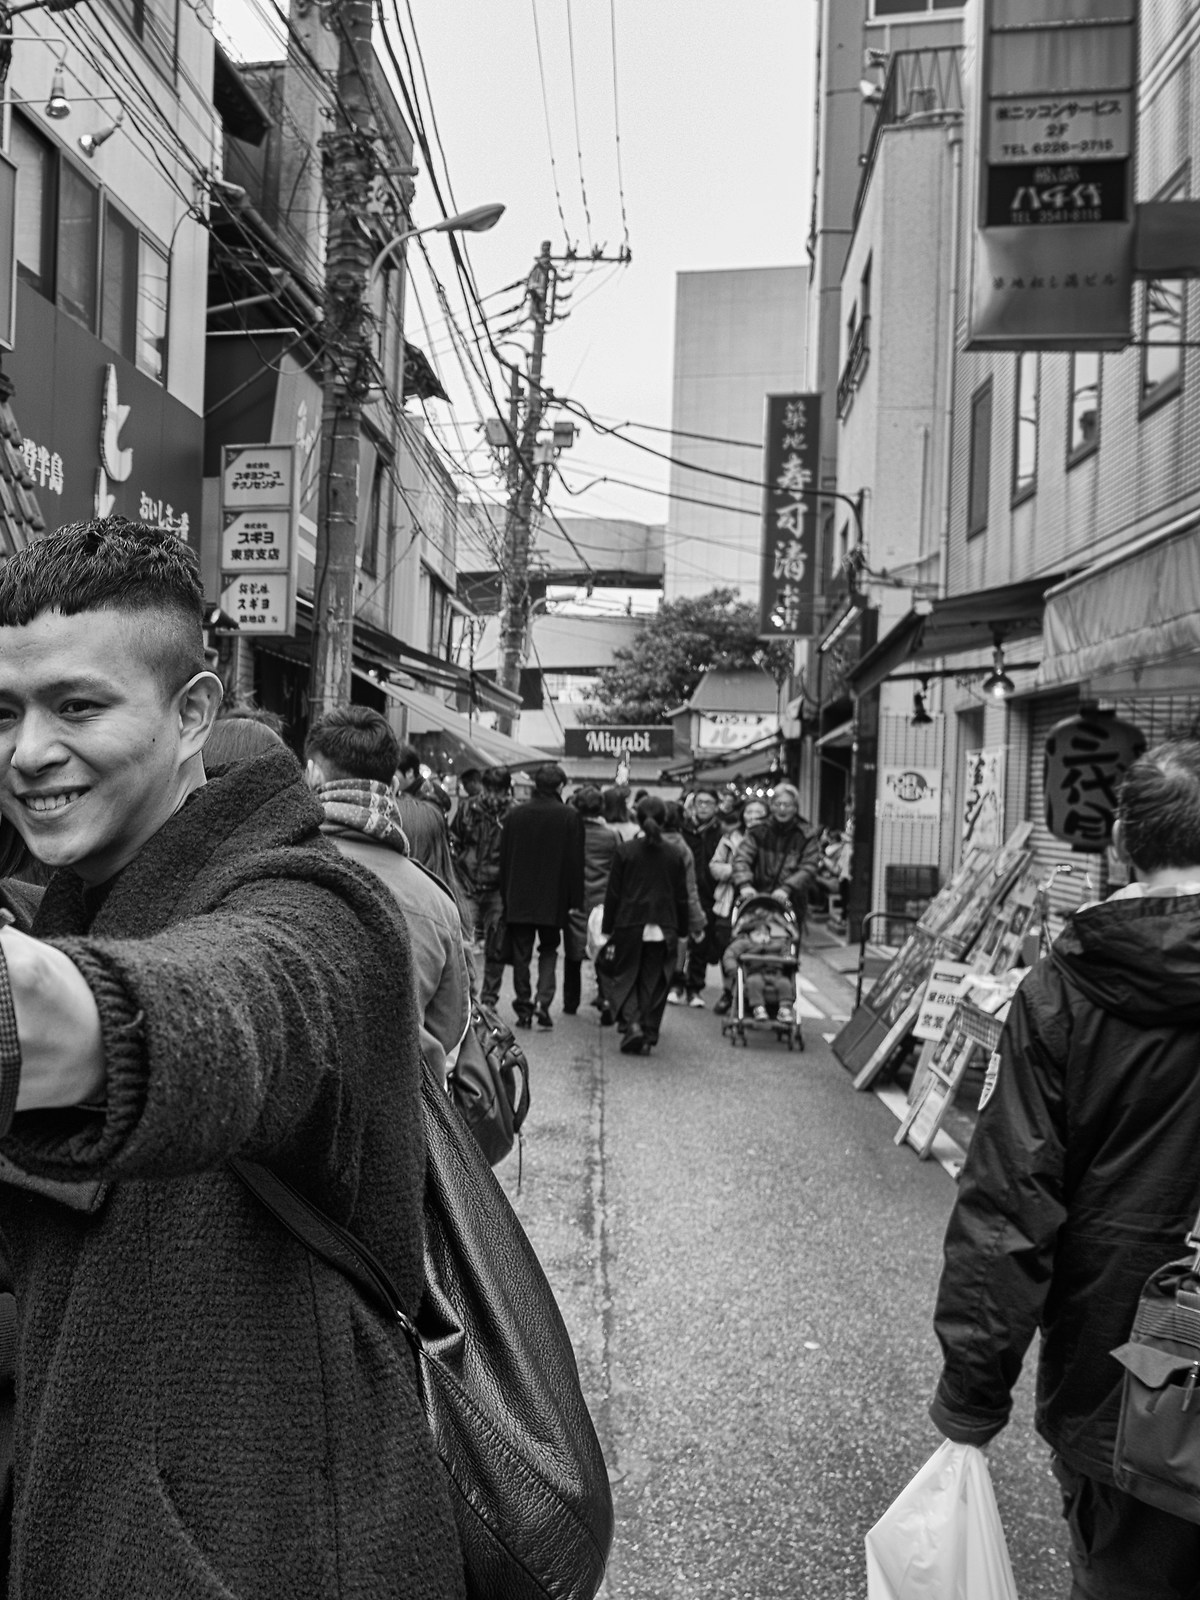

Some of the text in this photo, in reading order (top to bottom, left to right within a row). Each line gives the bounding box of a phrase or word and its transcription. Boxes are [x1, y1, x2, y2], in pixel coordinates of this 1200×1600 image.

[1002, 143, 1028, 155] TEL
[237, 531, 275, 545] スギヨ
[230, 548, 280, 561] 東京支店
[237, 597, 270, 611] スギヨ
[585, 731, 650, 757] Miyabi
[886, 773, 920, 792] FOR
[896, 783, 938, 800] RENT
